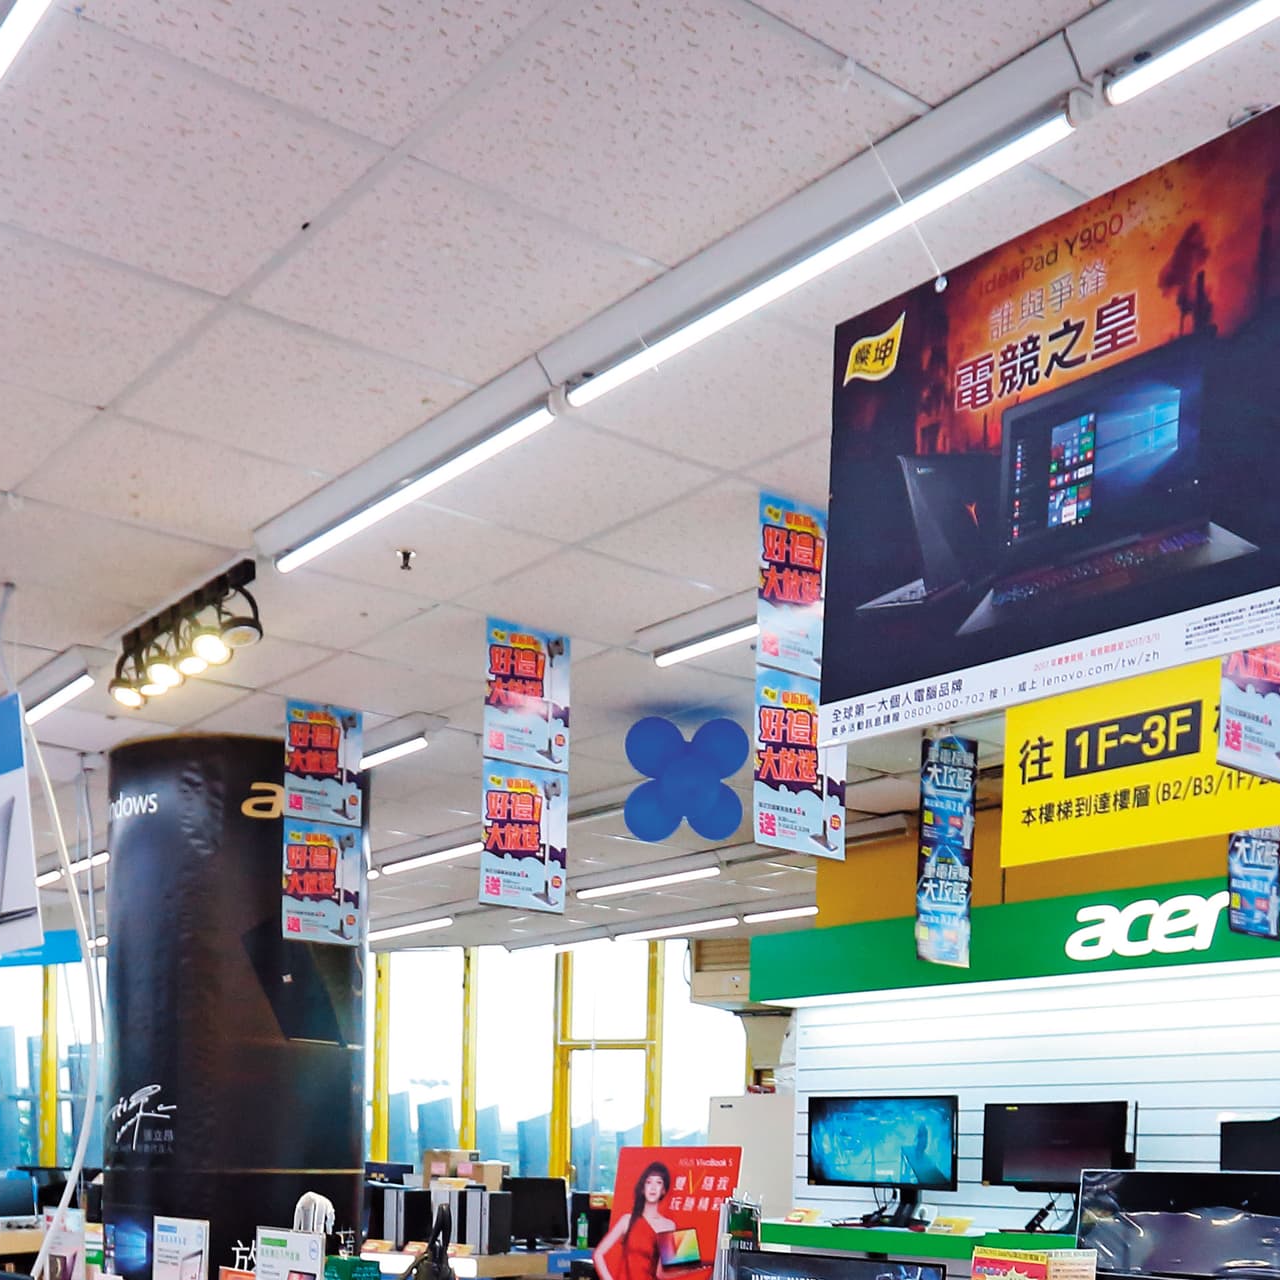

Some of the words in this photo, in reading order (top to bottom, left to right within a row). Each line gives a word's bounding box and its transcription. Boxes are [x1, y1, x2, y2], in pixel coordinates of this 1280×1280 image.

[979, 240, 1058, 296] IdeaPad
[1064, 213, 1124, 257] Y900
[988, 259, 1107, 341] 誰與爭鋒
[956, 292, 1140, 412] 電競之皇
[1042, 650, 1161, 687] lenovo.com/tw/zh
[832, 677, 964, 724] 全球第一大個人電腦品牌
[761, 706, 812, 743] 好禮
[1019, 738, 1054, 786] 往
[1072, 708, 1194, 771] 1F~3F
[760, 746, 817, 784] 大放送
[487, 792, 534, 821] 好禮
[1021, 784, 1152, 828] 本樓梯到達樓層
[487, 823, 540, 851] 大放送
[1064, 889, 1230, 962] acer
